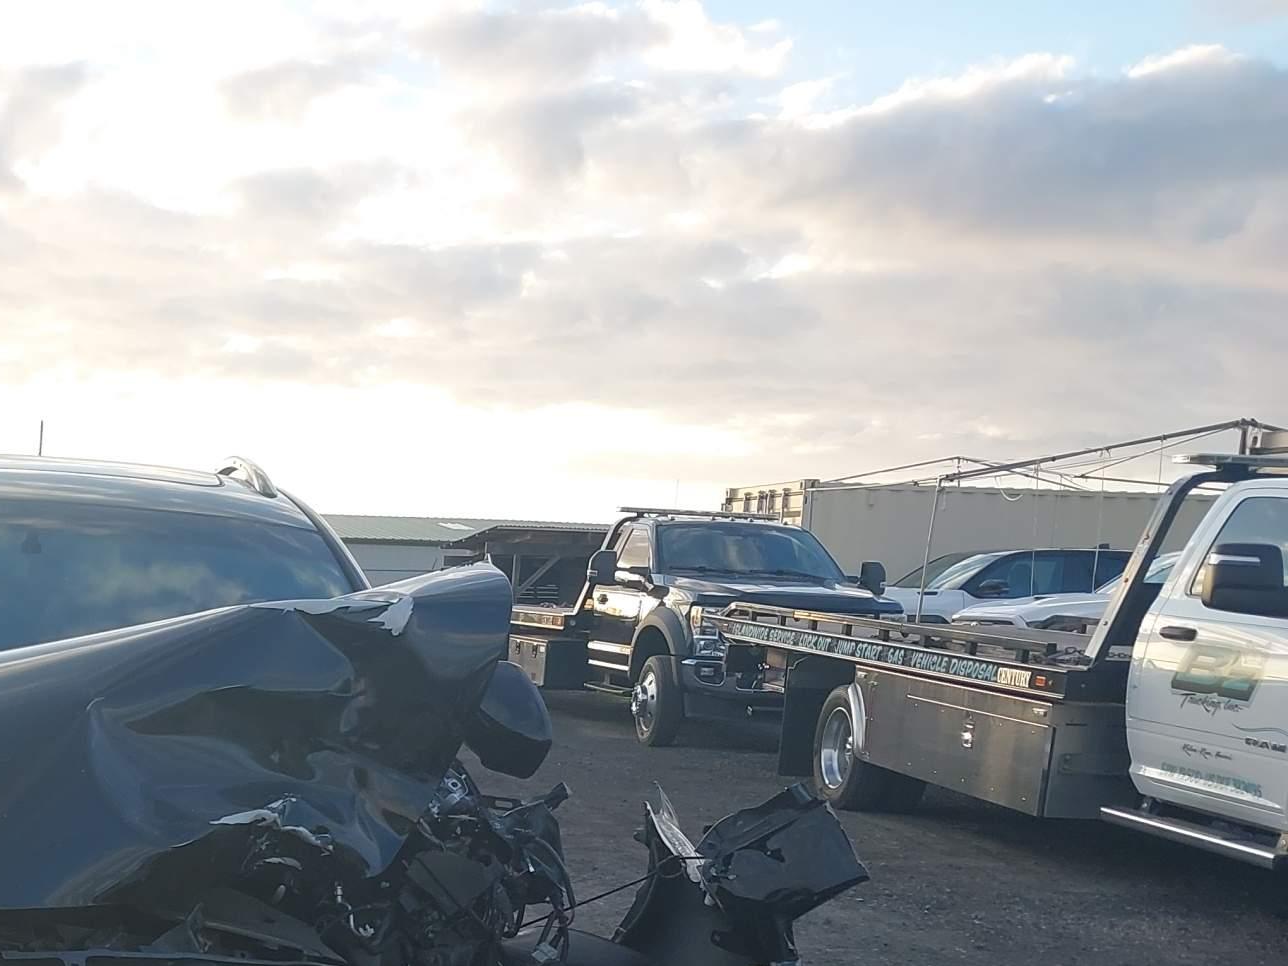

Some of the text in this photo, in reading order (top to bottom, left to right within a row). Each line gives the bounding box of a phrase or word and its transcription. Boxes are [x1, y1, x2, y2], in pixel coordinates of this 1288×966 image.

[733, 623, 998, 681] ISLANDWIDE SERVICE LOCK OUT JUMP START GAS VEHICLE DISPOSAL
[997, 667, 1032, 688] CENTURY
[1245, 737, 1288, 753] RAM
